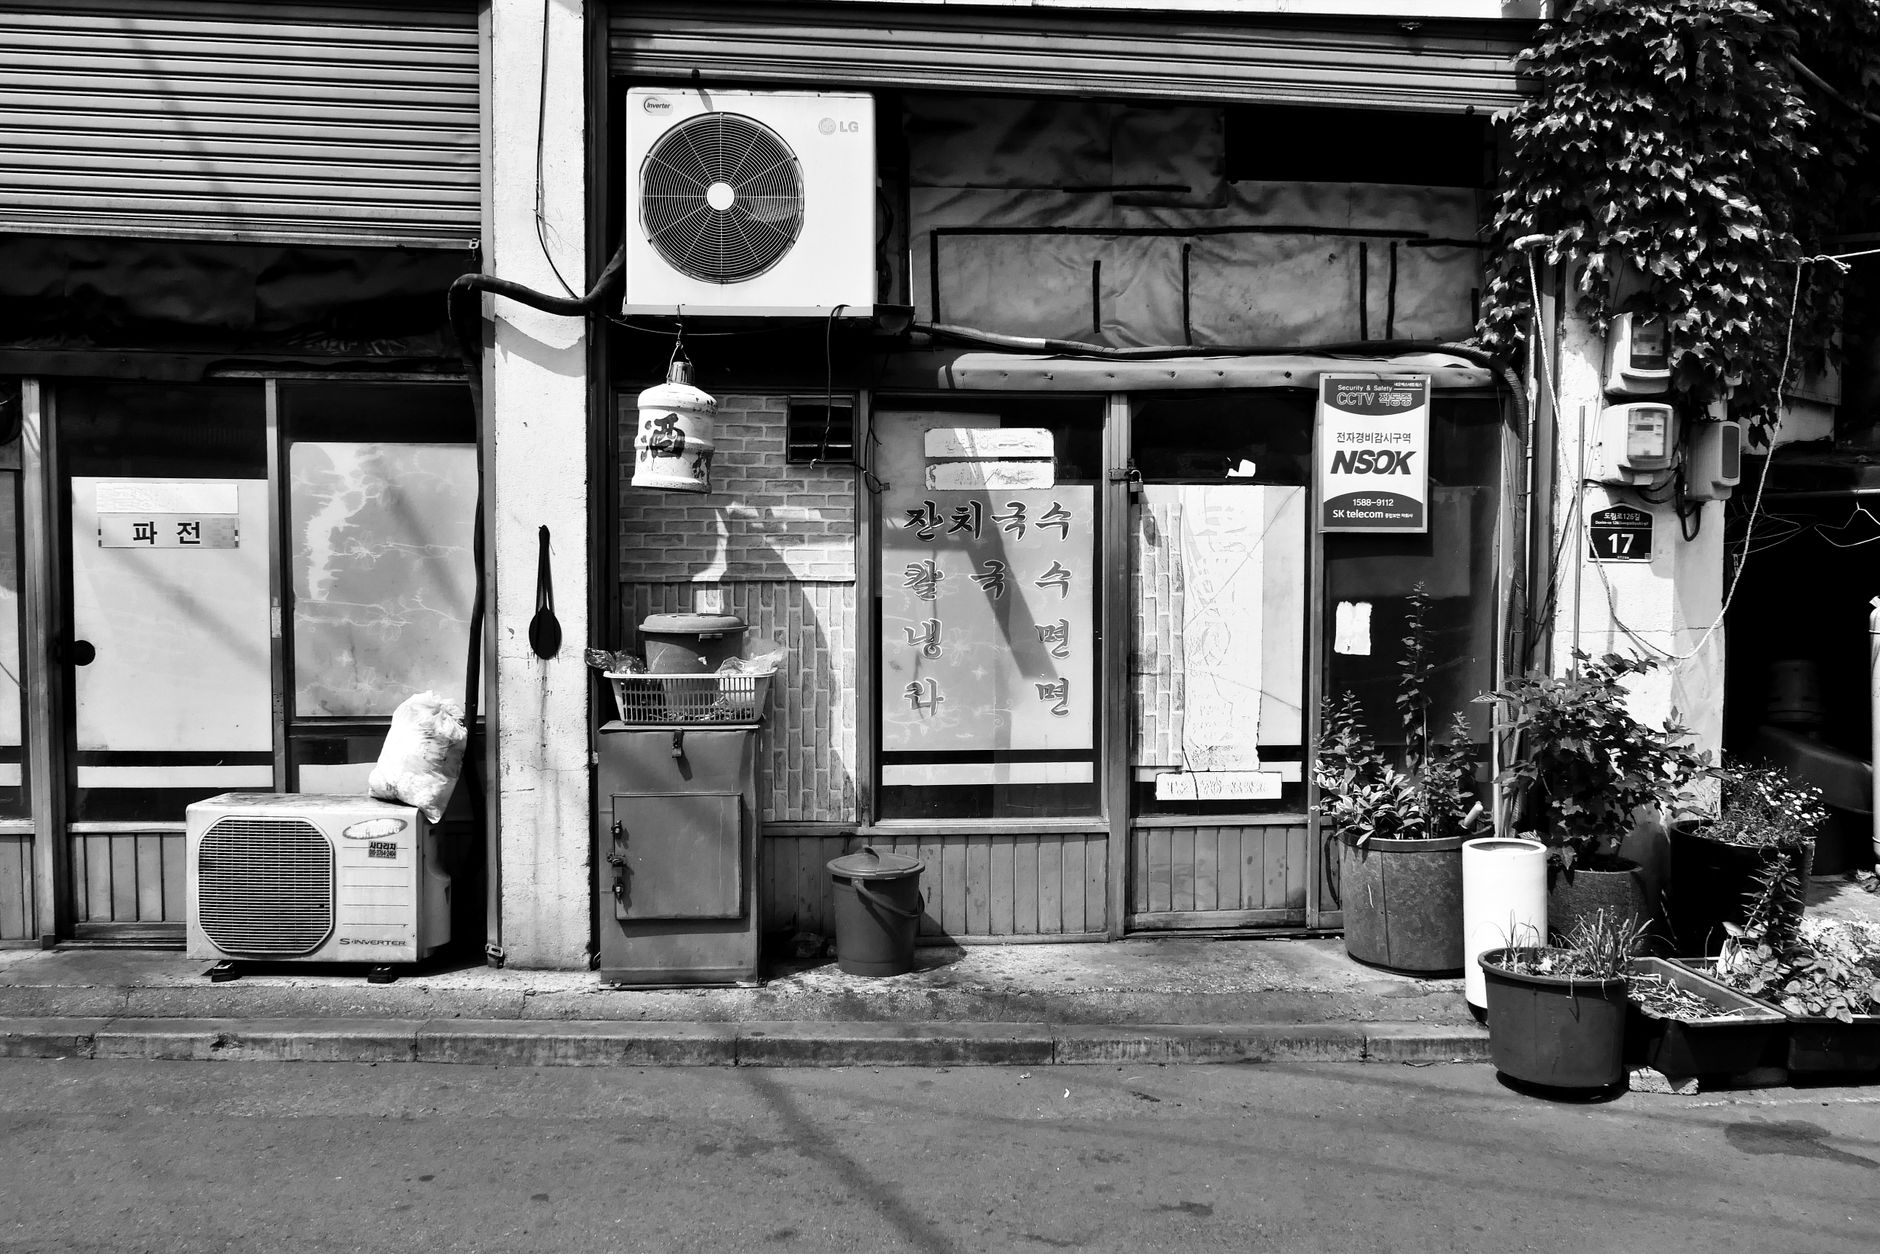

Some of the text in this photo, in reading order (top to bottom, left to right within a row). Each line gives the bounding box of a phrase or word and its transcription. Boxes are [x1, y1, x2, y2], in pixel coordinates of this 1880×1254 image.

[839, 120, 859, 133] LG
[1373, 384, 1393, 392] Safety
[1336, 391, 1413, 407] CCTV 작동중
[1336, 431, 1412, 444] 전자경비감시구역
[1330, 449, 1417, 475] NSOK
[1352, 498, 1394, 507] 1588-9112
[1332, 509, 1345, 518] SK
[1346, 509, 1384, 519] telecom
[903, 500, 1072, 542] 잔치국수
[1607, 533, 1634, 554] 17
